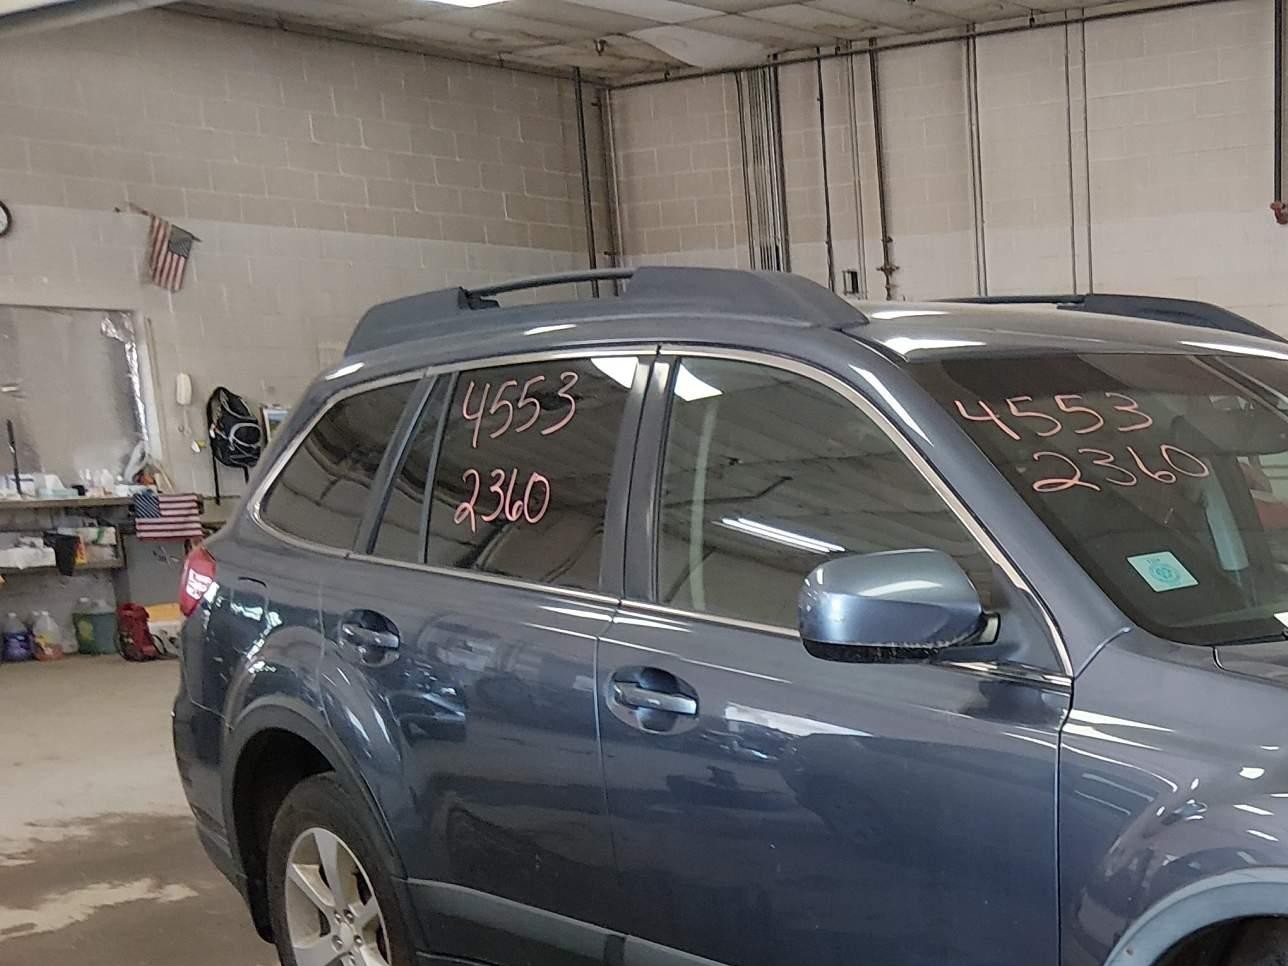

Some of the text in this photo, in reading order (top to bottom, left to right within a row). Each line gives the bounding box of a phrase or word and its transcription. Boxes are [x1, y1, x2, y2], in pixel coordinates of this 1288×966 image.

[463, 371, 580, 448] 4553
[953, 391, 1153, 441] 4553
[1031, 444, 1210, 493] 2360
[453, 467, 550, 533] 2360
